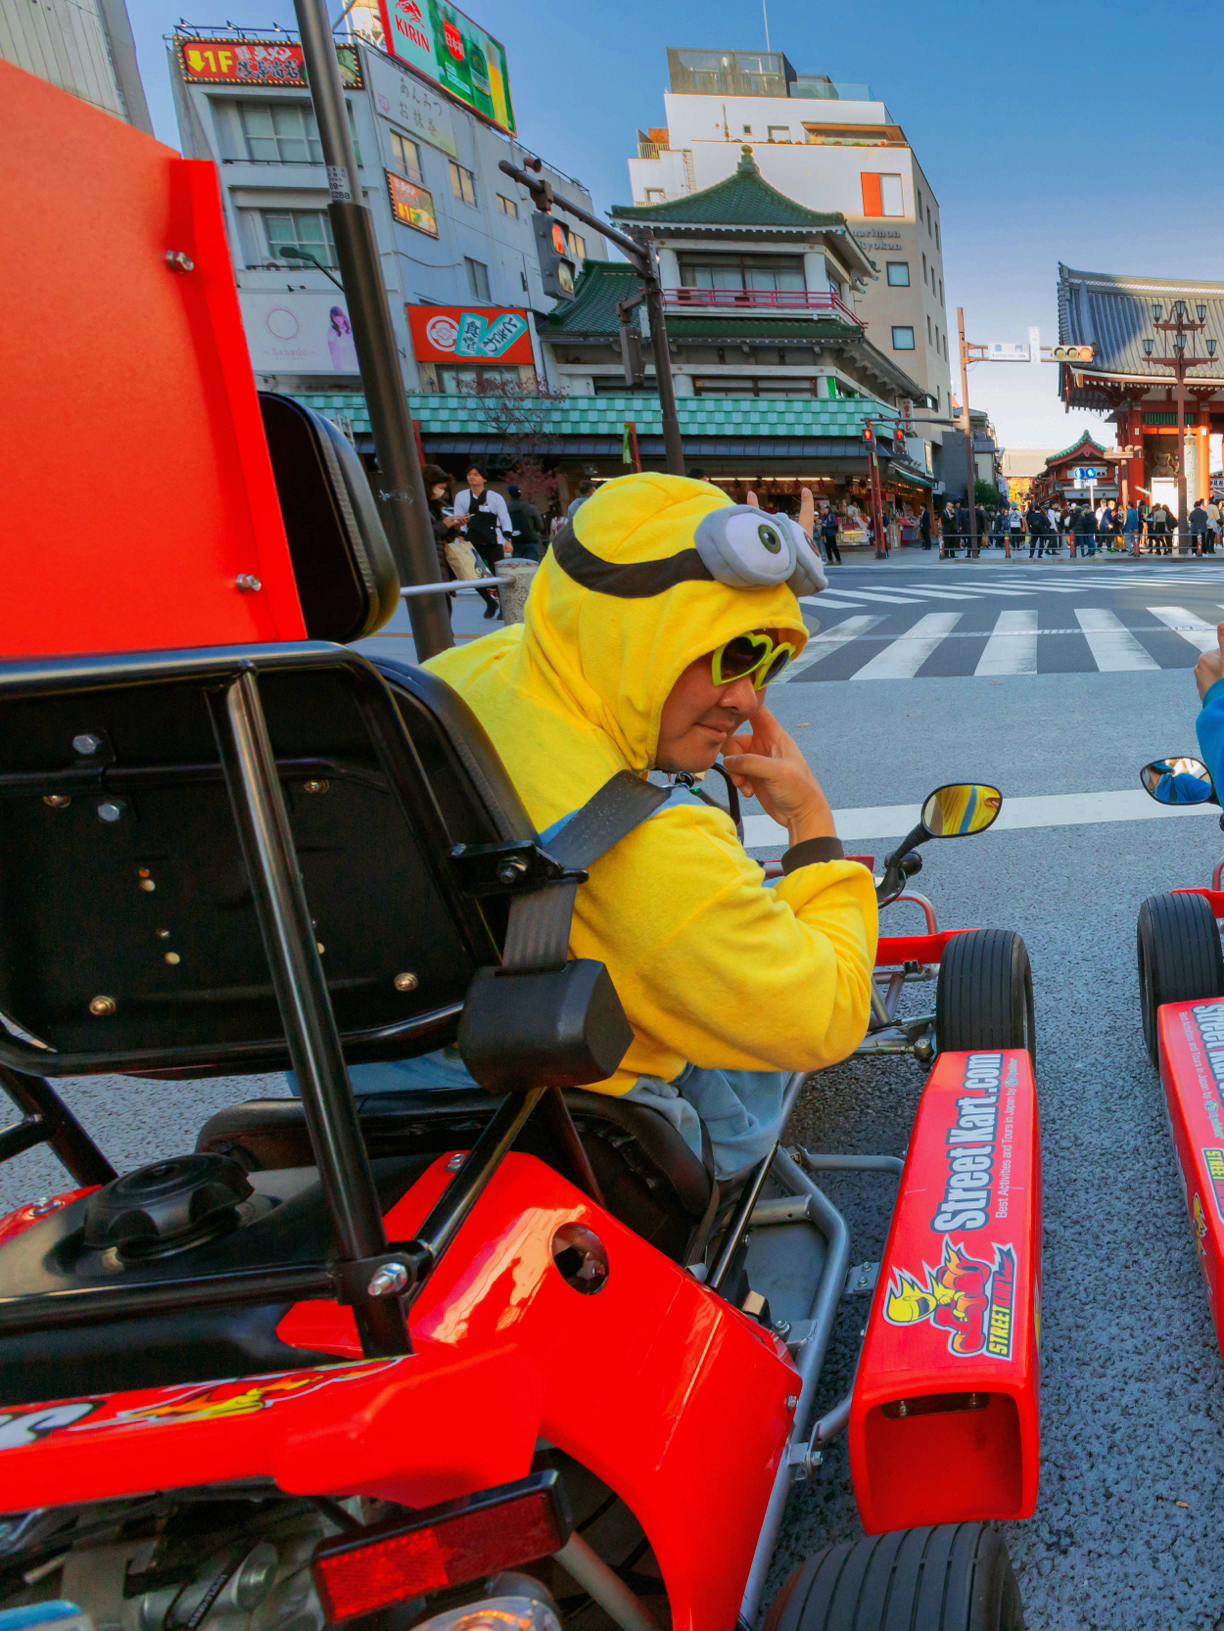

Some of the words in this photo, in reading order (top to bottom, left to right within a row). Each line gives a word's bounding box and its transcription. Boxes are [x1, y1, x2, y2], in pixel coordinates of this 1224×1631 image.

[395, 15, 431, 54] KIRIN
[203, 50, 235, 73] 1F
[1004, 1095, 1016, 1115] Japan
[1001, 1123, 1013, 1143] Tours
[1001, 1144, 1012, 1158] and
[997, 1159, 1011, 1195] Activities
[933, 1145, 994, 1235] Street
[995, 1197, 1008, 1217] Best
[988, 1303, 1010, 1355] STREET
